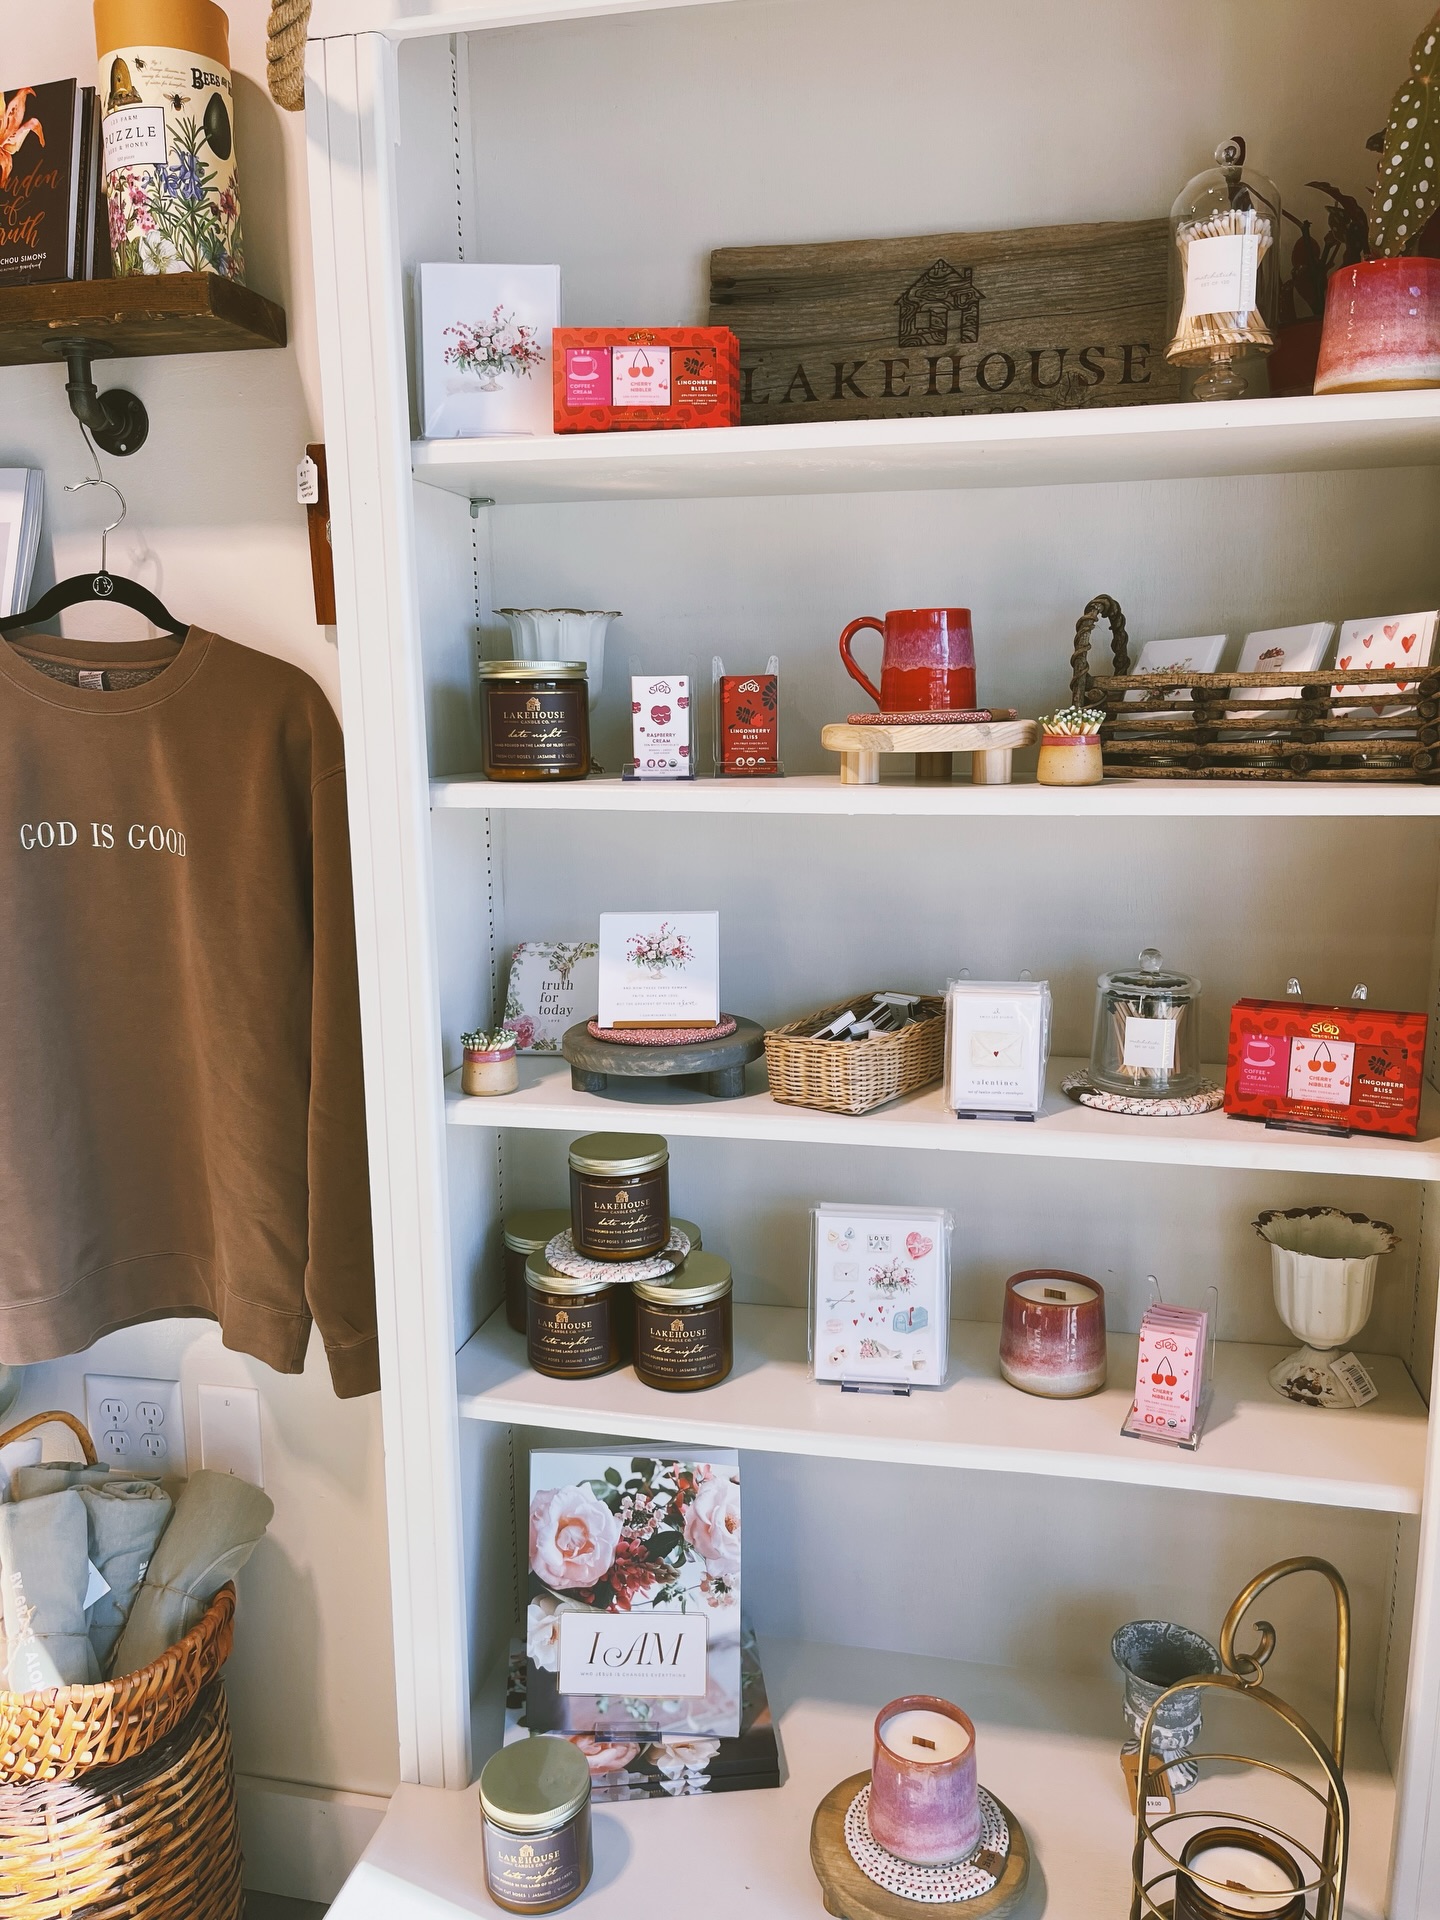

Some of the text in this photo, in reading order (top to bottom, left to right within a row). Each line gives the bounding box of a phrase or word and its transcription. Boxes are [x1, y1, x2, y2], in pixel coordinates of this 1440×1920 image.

[120, 114, 138, 123] FARM
[105, 126, 156, 148] PUZZLE
[20, 252, 47, 263] SIMONS
[741, 343, 1153, 405] LAKEHOUSE
[503, 711, 565, 719] LAKEHOUSE
[20, 821, 186, 857] GOD IS GOOD
[541, 980, 574, 990] truth
[540, 992, 559, 1003] for
[538, 1004, 573, 1017] today
[594, 1199, 650, 1210] LAKEHOUSE
[537, 1319, 592, 1330] LAKEHOUSE
[650, 1327, 707, 1338] LAKEHOUSE
[1152, 1387, 1173, 1395] CHERRY
[586, 1631, 687, 1667] I AM
[498, 1850, 560, 1864] LAKEHOUSE
